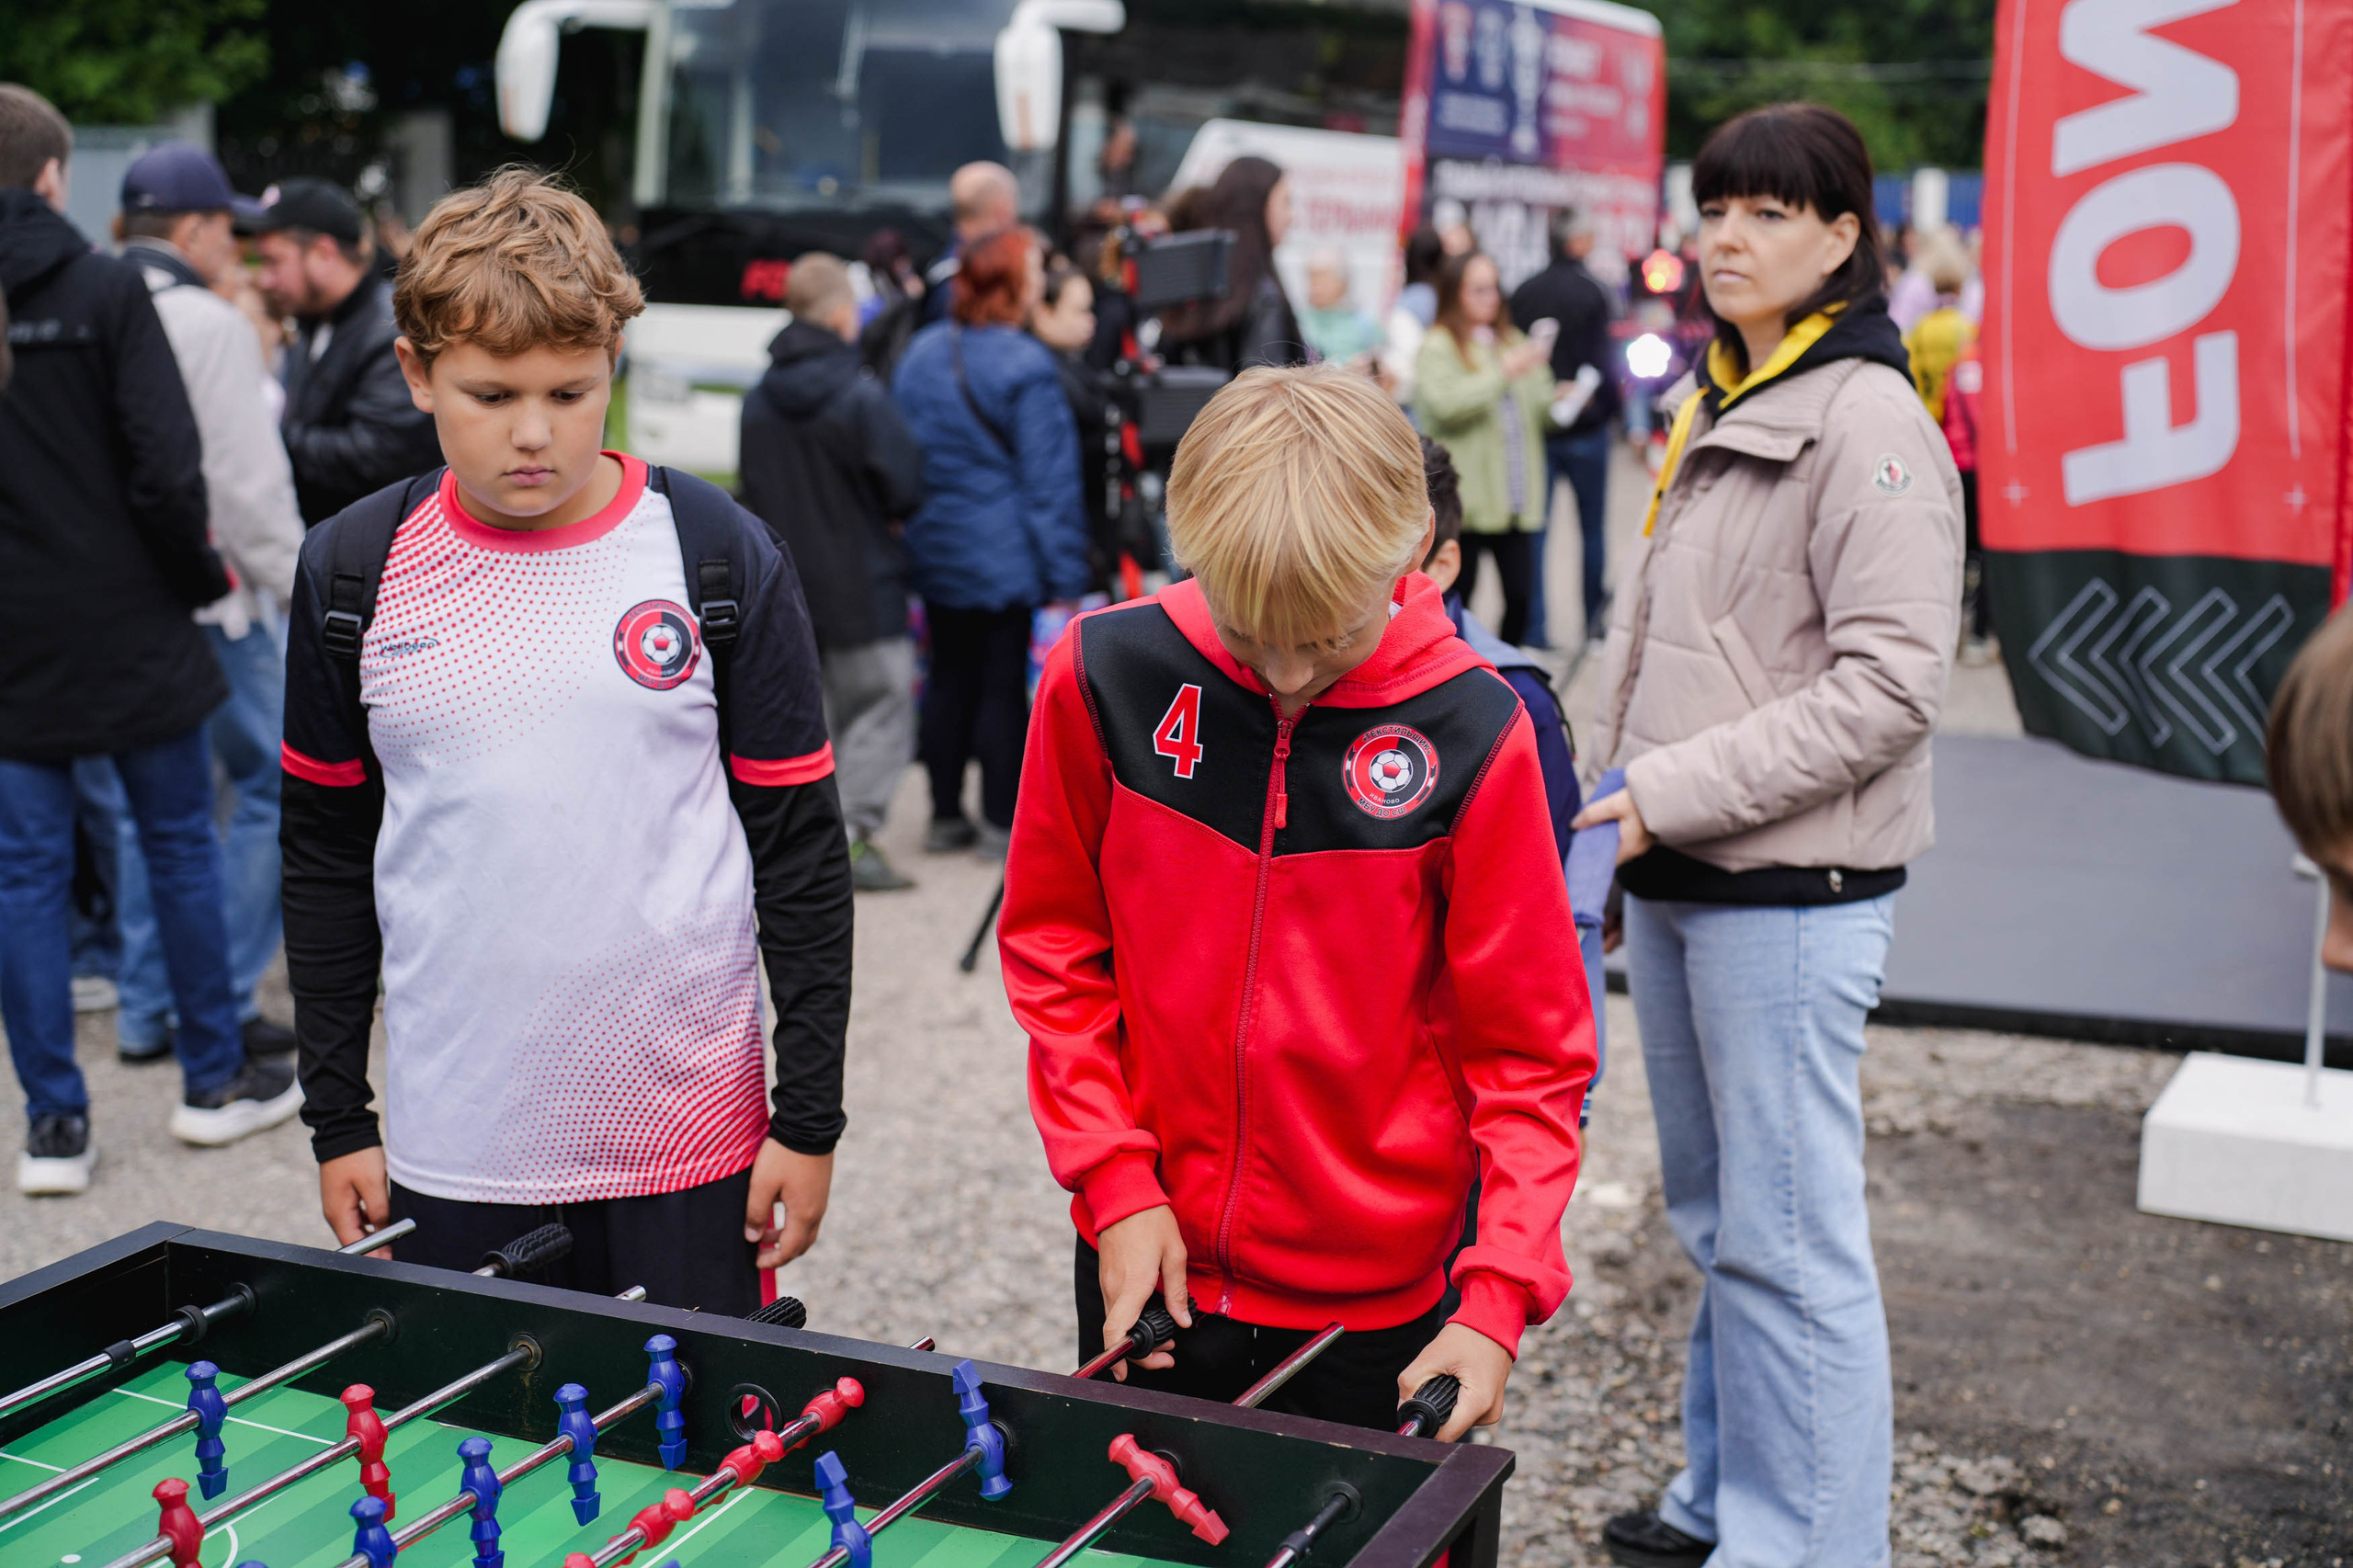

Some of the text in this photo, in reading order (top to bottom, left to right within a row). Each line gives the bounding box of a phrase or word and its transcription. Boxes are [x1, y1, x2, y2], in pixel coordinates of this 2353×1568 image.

[1153, 683, 1203, 778] 4
[1358, 798, 1375, 812] МБУ
[1392, 807, 1406, 816] СШ
[1369, 792, 1400, 804] ИВАНОВО
